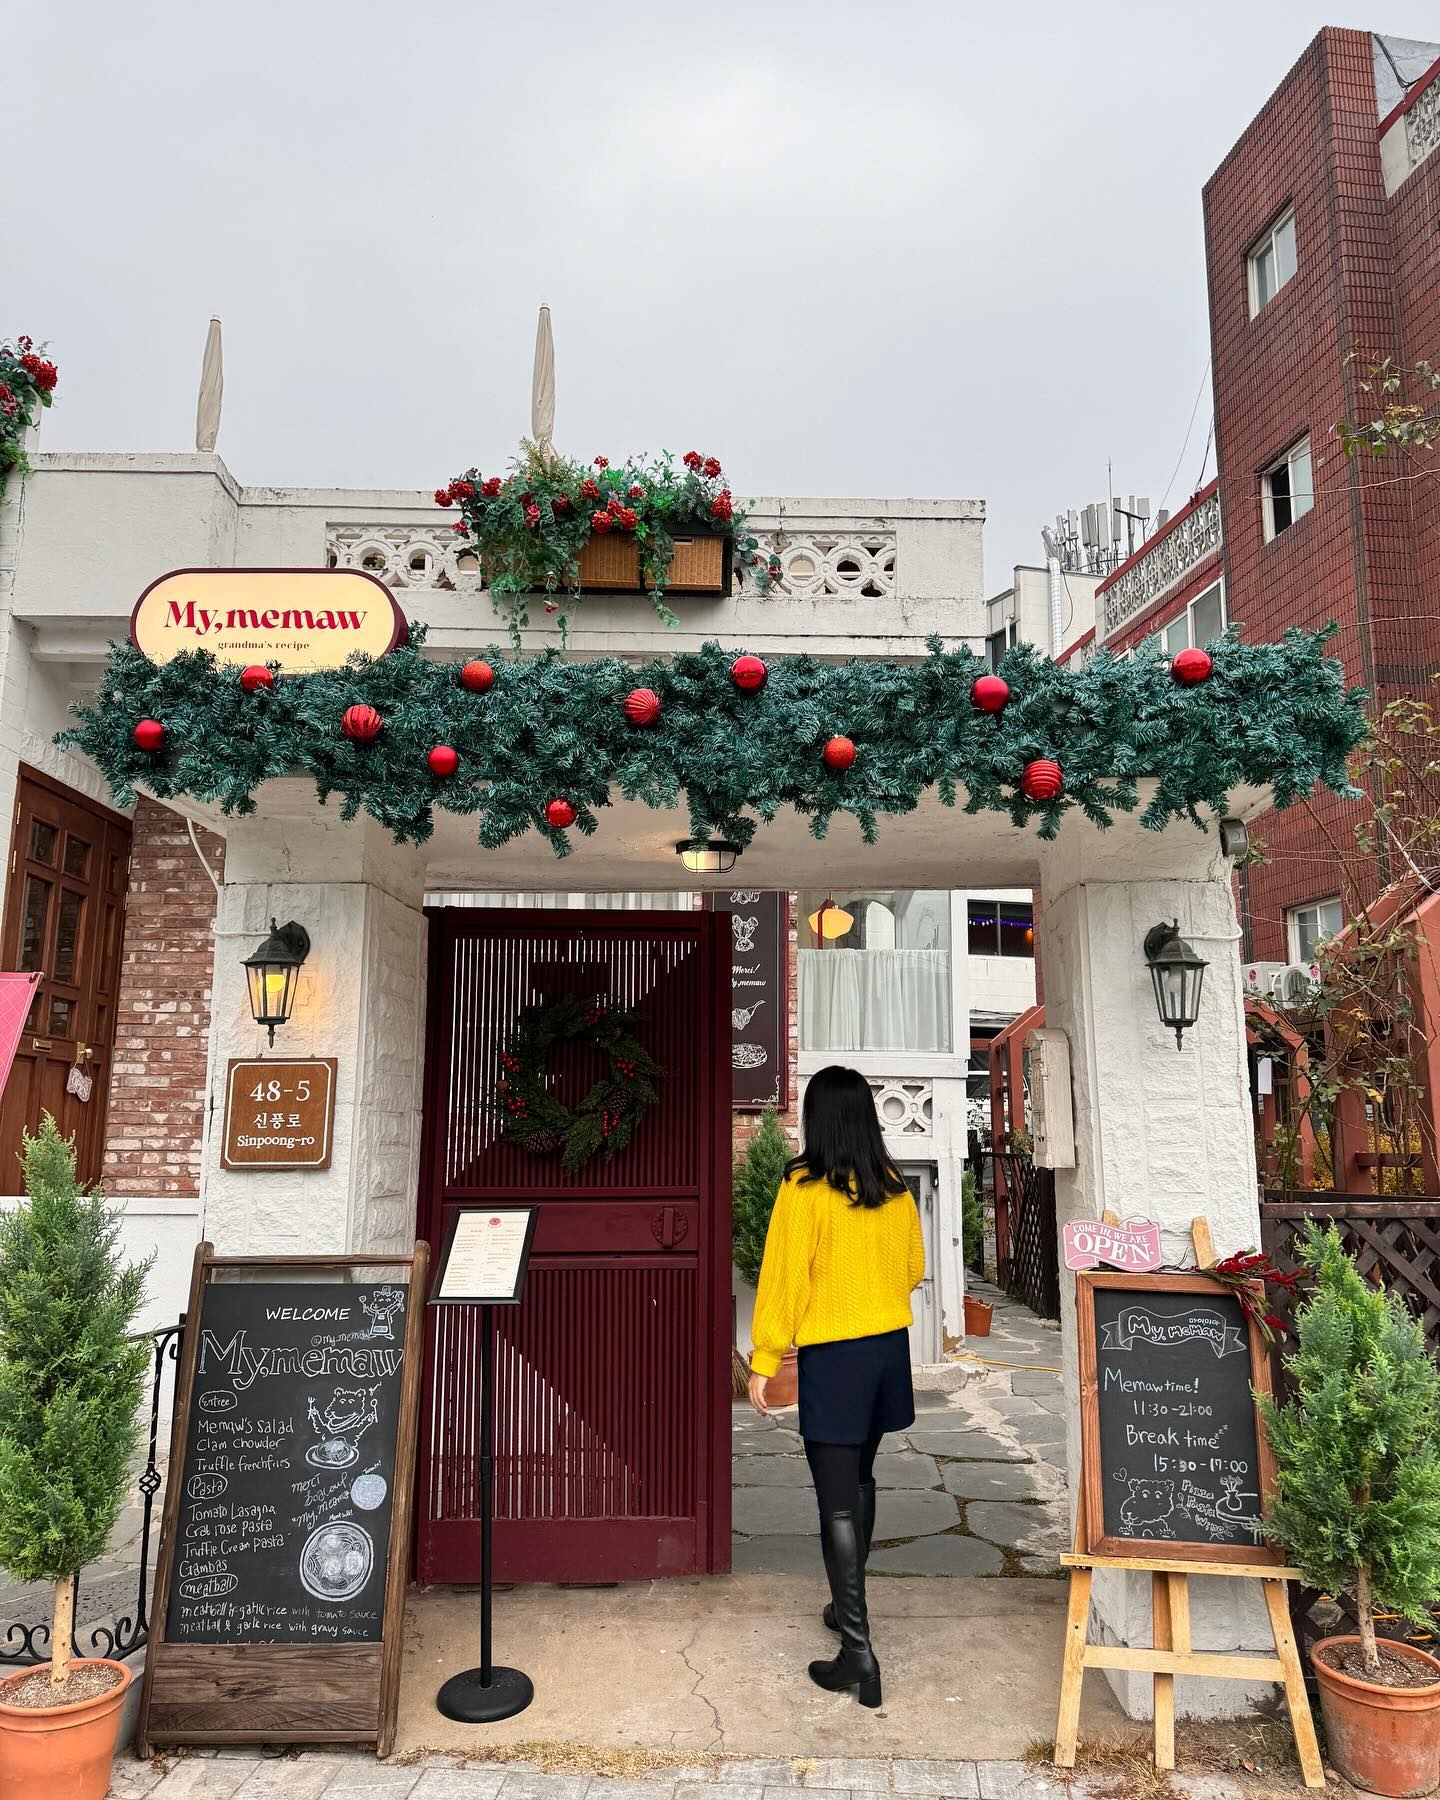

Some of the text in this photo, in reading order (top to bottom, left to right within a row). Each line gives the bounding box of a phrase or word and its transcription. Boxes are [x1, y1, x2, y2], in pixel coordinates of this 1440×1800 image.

[163, 600, 368, 635] My,memaw
[217, 640, 310, 651] grandma's recipe
[249, 1080, 311, 1102] 48-5
[253, 1112, 302, 1129] 신풍로
[237, 1135, 315, 1149] Sinpoong-ro
[1073, 1223, 1097, 1233] COME
[1114, 1232, 1126, 1242] WE
[1130, 1235, 1148, 1244] ARE
[1073, 1232, 1151, 1264] OPEN
[266, 1307, 351, 1321] WELCOME
[197, 1437, 227, 1451] Clam
[1126, 1424, 1180, 1446] Break
[194, 1455, 235, 1471] Truffle
[192, 1479, 223, 1496] Pasta
[1182, 1480, 1214, 1499] Pizza
[187, 1502, 276, 1521] Tomato Lasagna
[1187, 1495, 1216, 1517] Pasta
[1195, 1514, 1224, 1533] Wine
[182, 1541, 218, 1558] Truffle
[221, 1540, 250, 1555] Cream
[184, 1576, 232, 1595] meatball
[263, 1621, 282, 1631] rice
[288, 1620, 307, 1632] with
[311, 1623, 339, 1637] gravy
[342, 1625, 369, 1637] sauce
